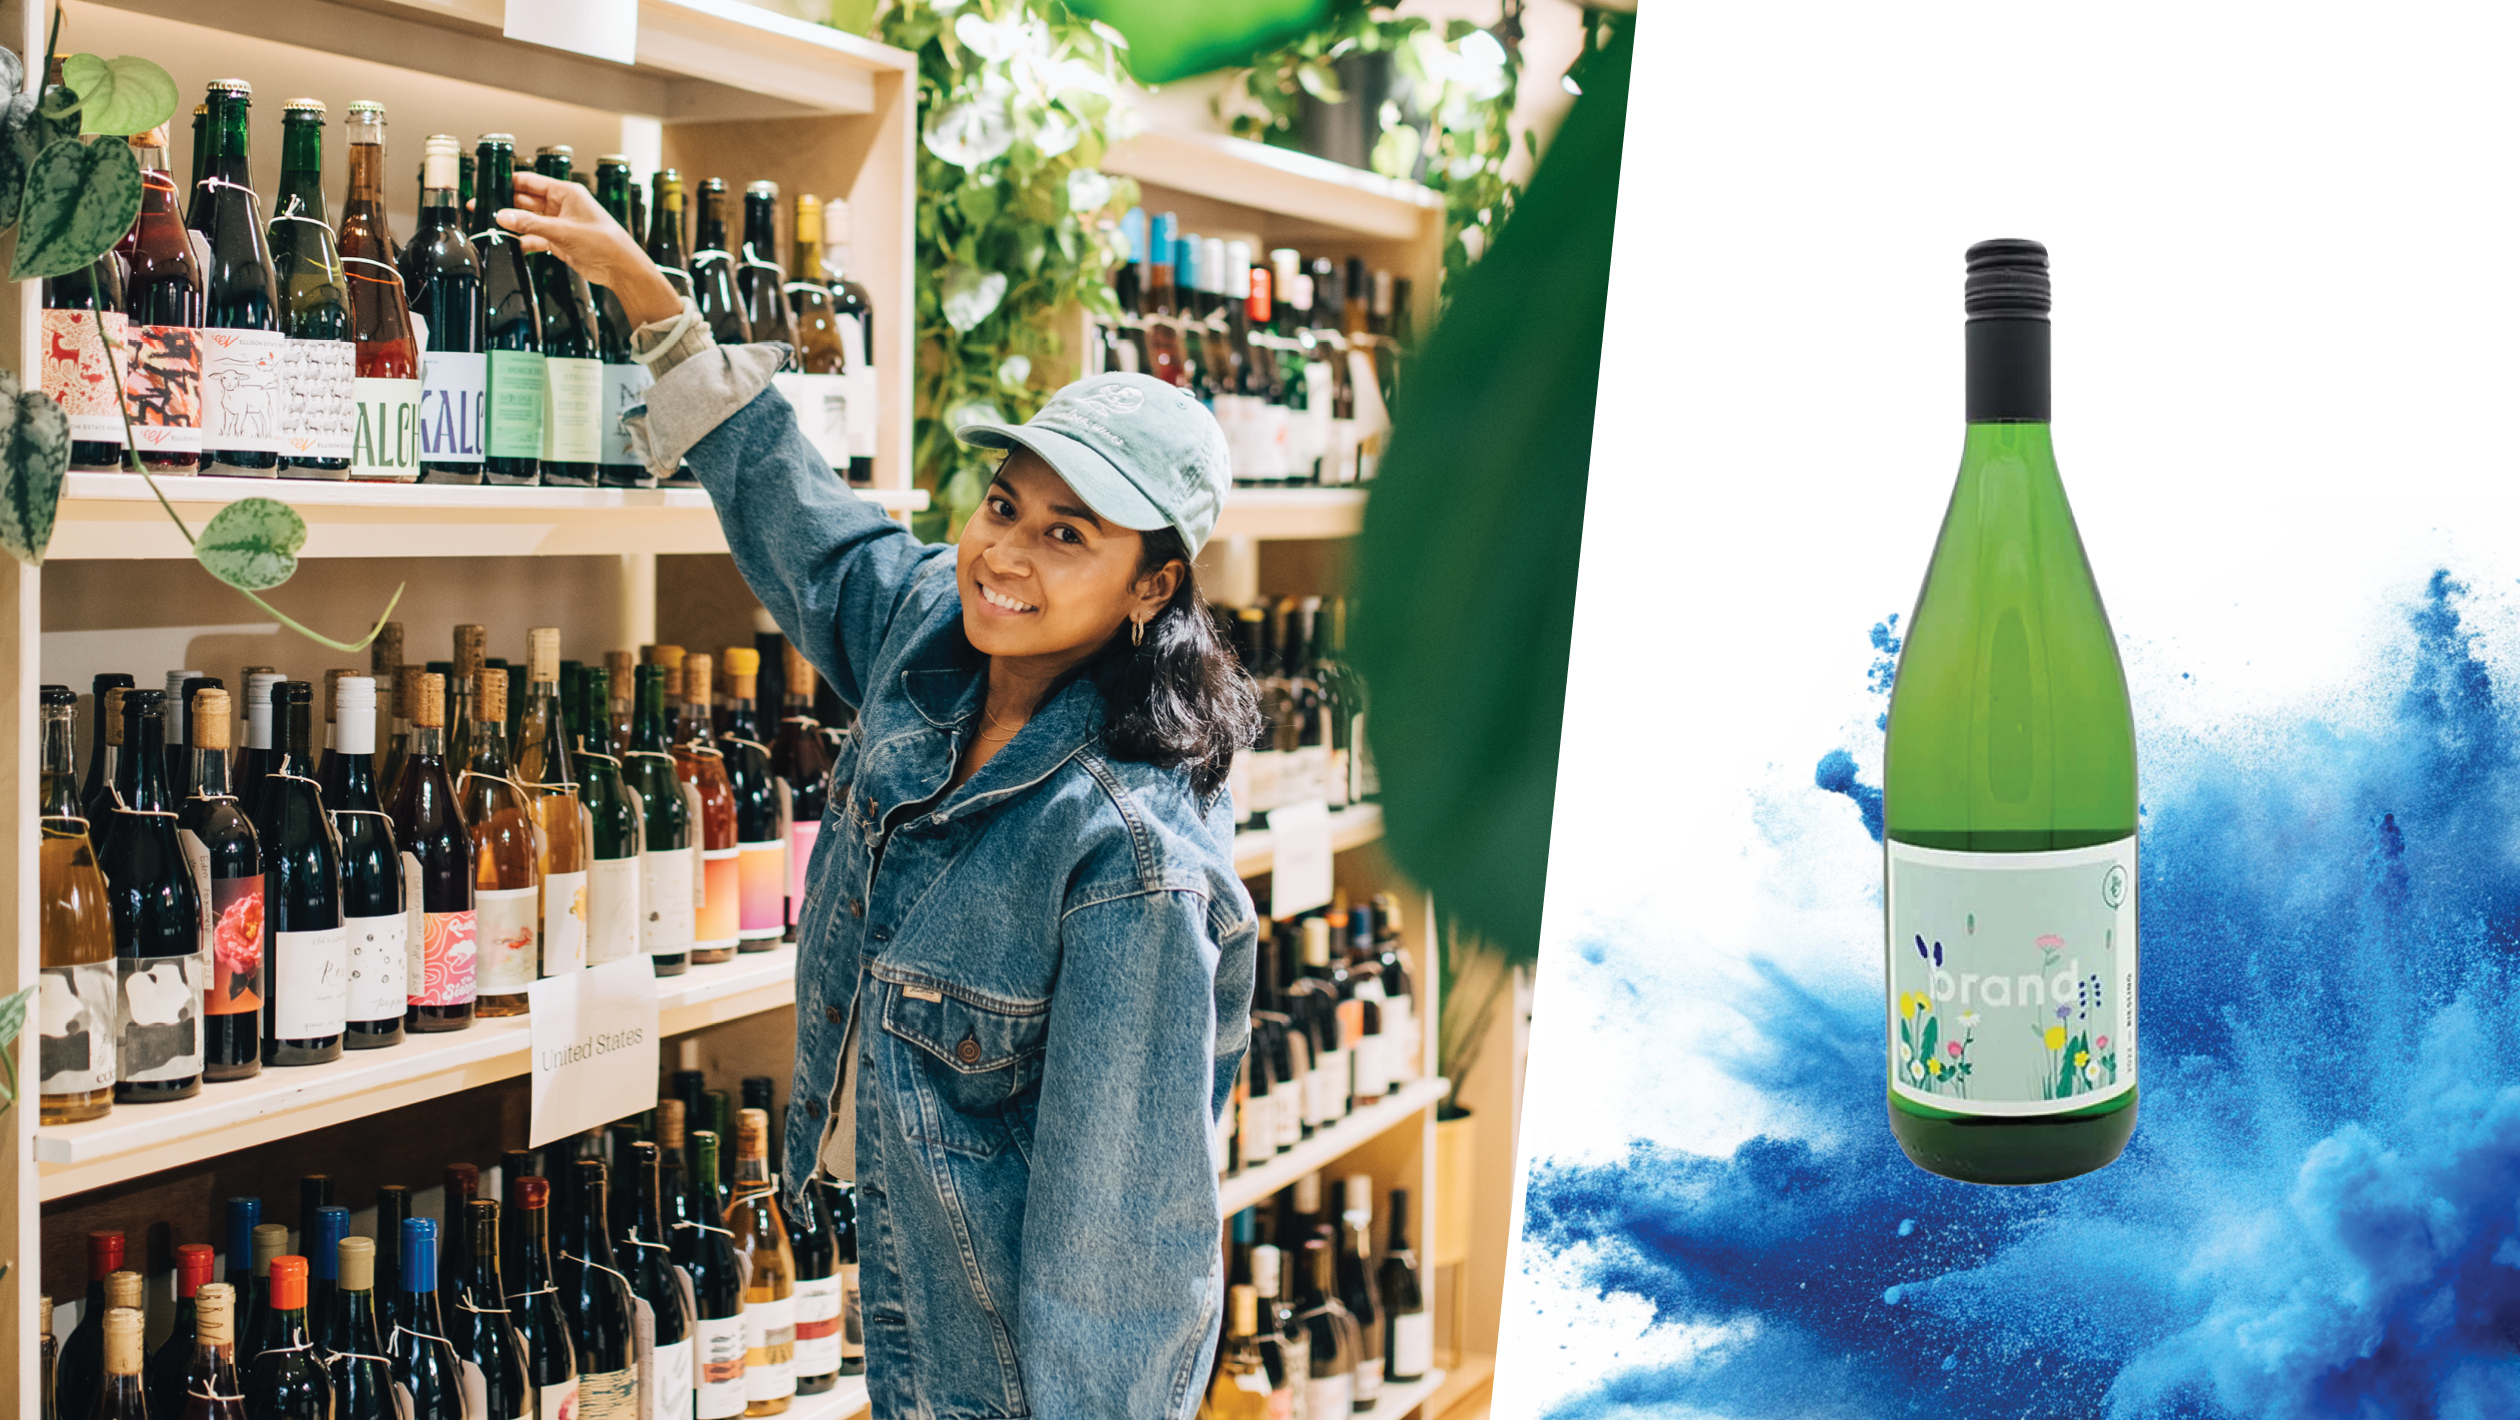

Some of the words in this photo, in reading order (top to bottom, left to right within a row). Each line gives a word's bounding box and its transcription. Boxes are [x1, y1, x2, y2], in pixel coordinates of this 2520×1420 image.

[1929, 957, 2079, 1007] brand
[542, 1036, 592, 1072] United
[596, 1028, 643, 1055] States
